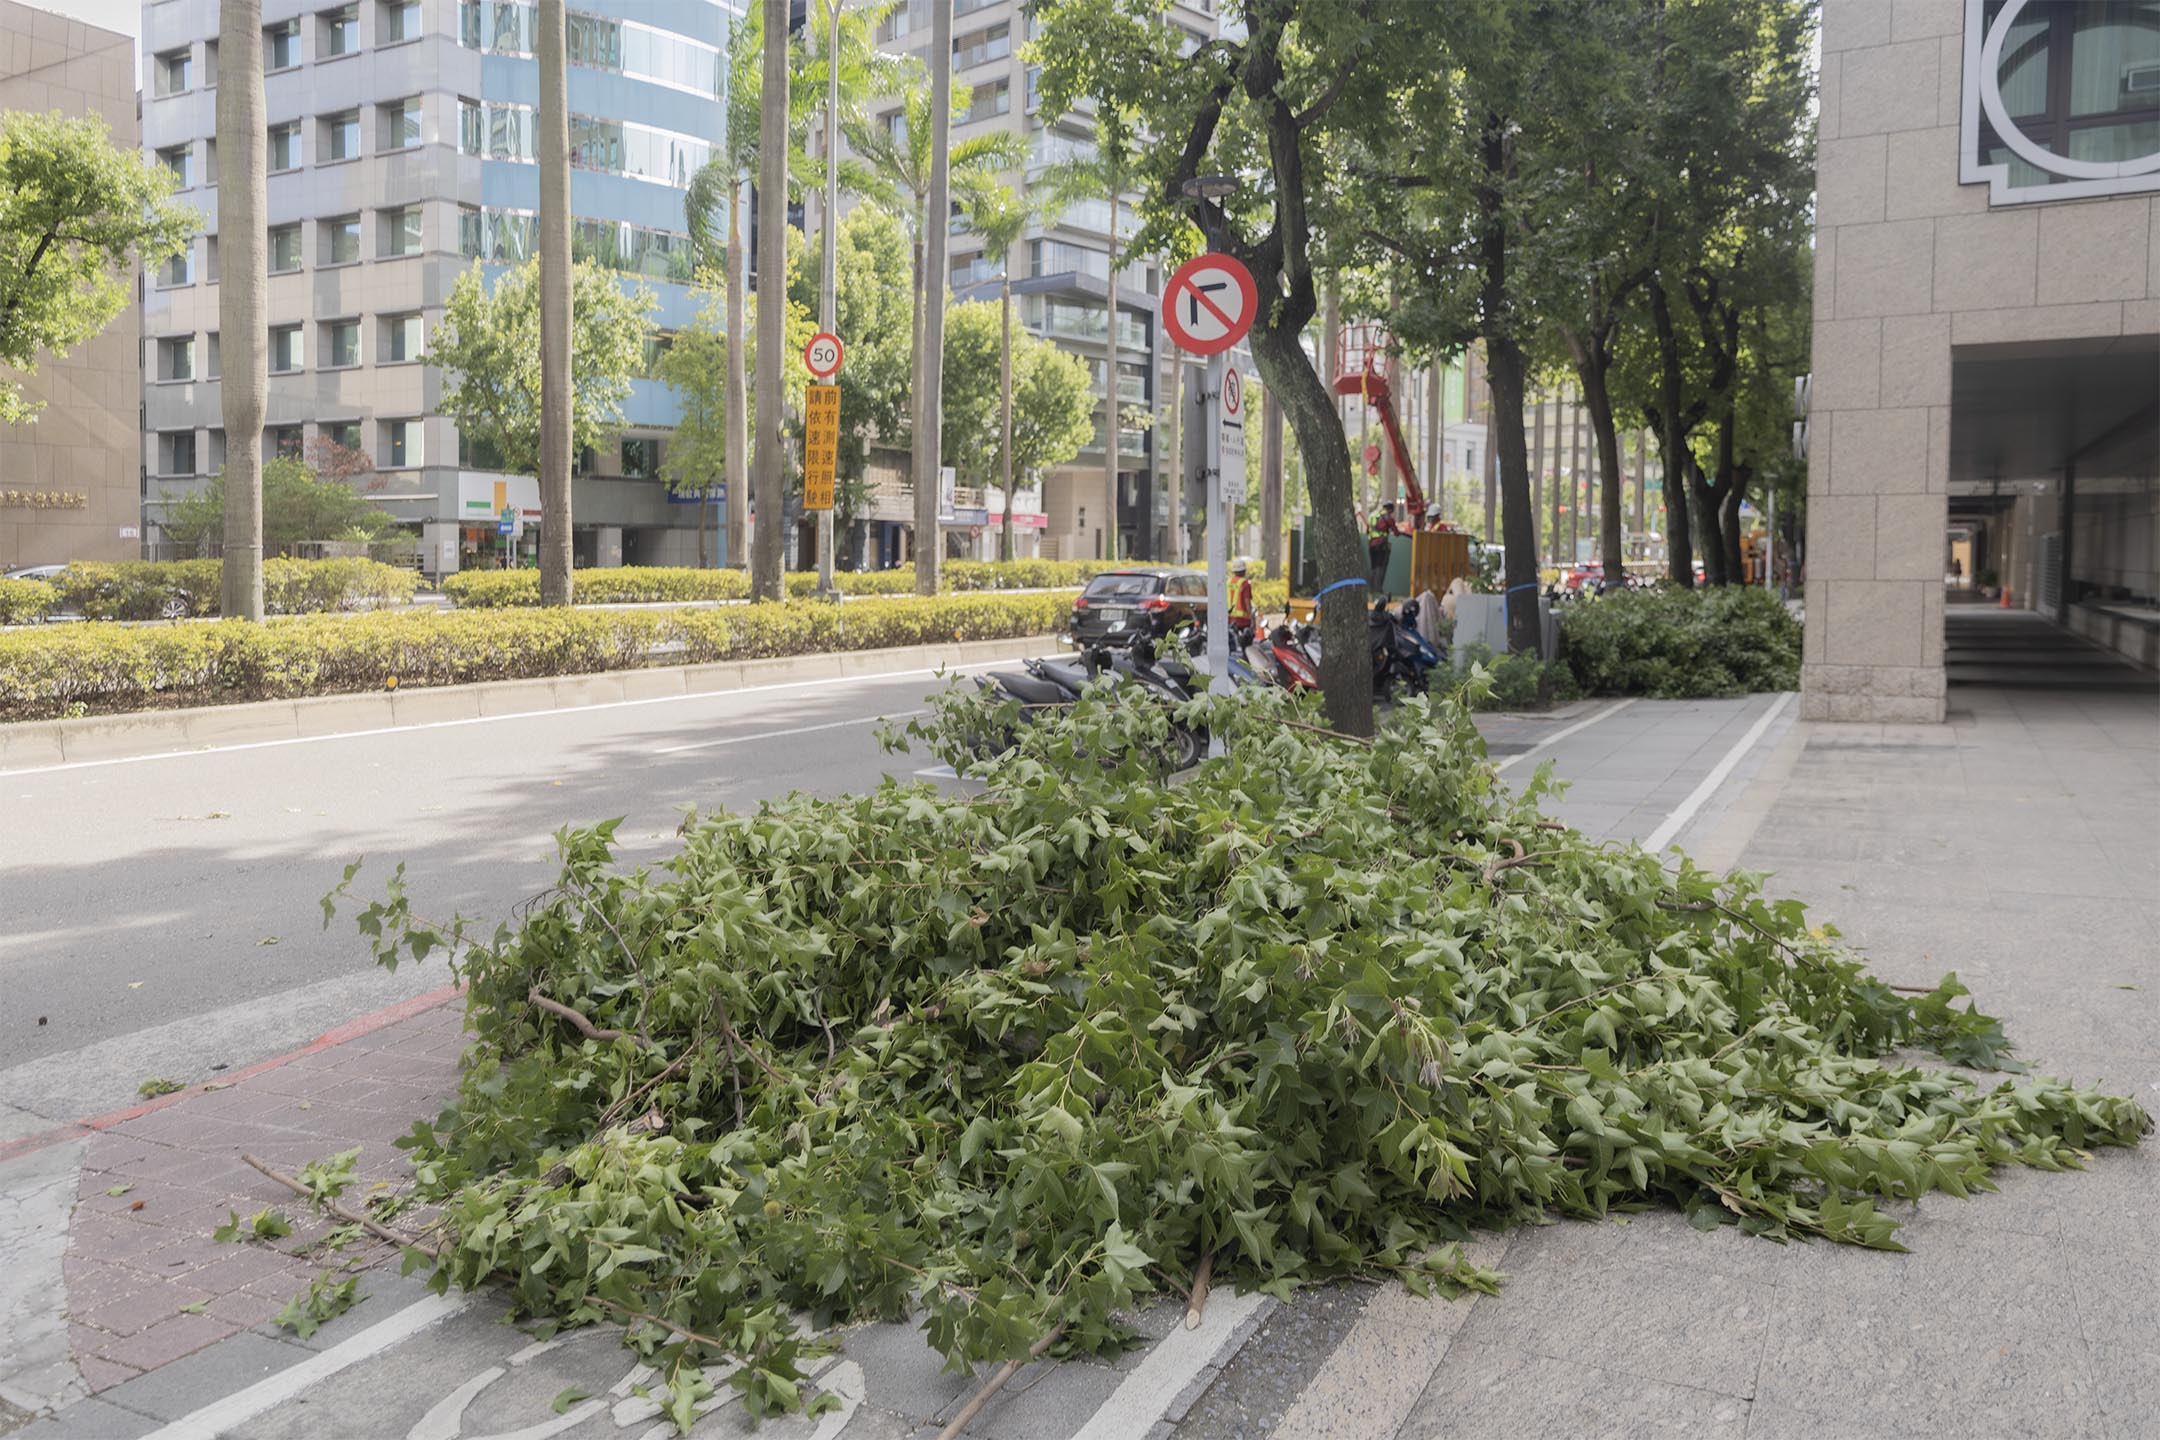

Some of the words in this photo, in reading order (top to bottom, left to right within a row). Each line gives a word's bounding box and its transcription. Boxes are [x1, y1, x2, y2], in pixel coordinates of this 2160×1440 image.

[813, 347, 835, 363] 50
[806, 389, 822, 505] 請依速限行駛
[820, 389, 837, 505] 前有測速照相
